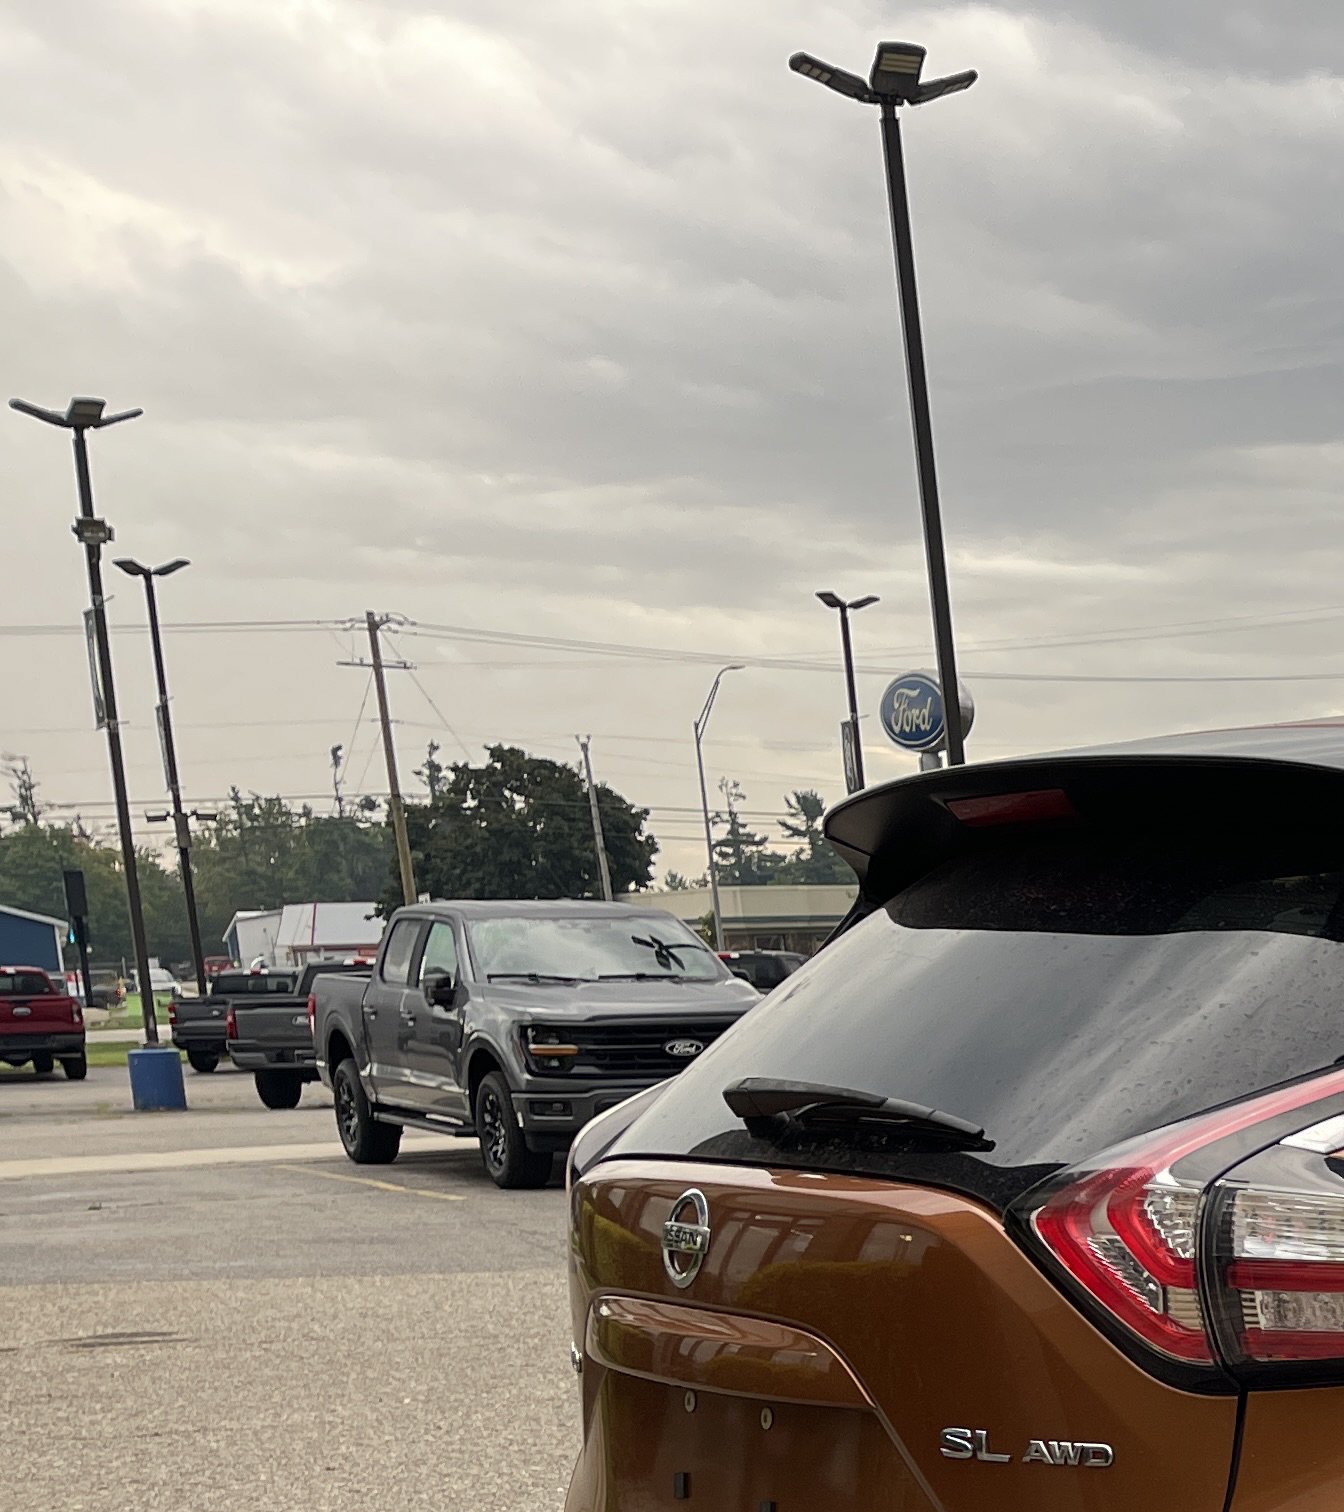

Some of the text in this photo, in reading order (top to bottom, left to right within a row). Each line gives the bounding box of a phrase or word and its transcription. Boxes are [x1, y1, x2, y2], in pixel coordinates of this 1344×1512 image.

[891, 687, 932, 734] Ford
[672, 1043, 697, 1055] Ford
[940, 1427, 1115, 1467] SL AWD
